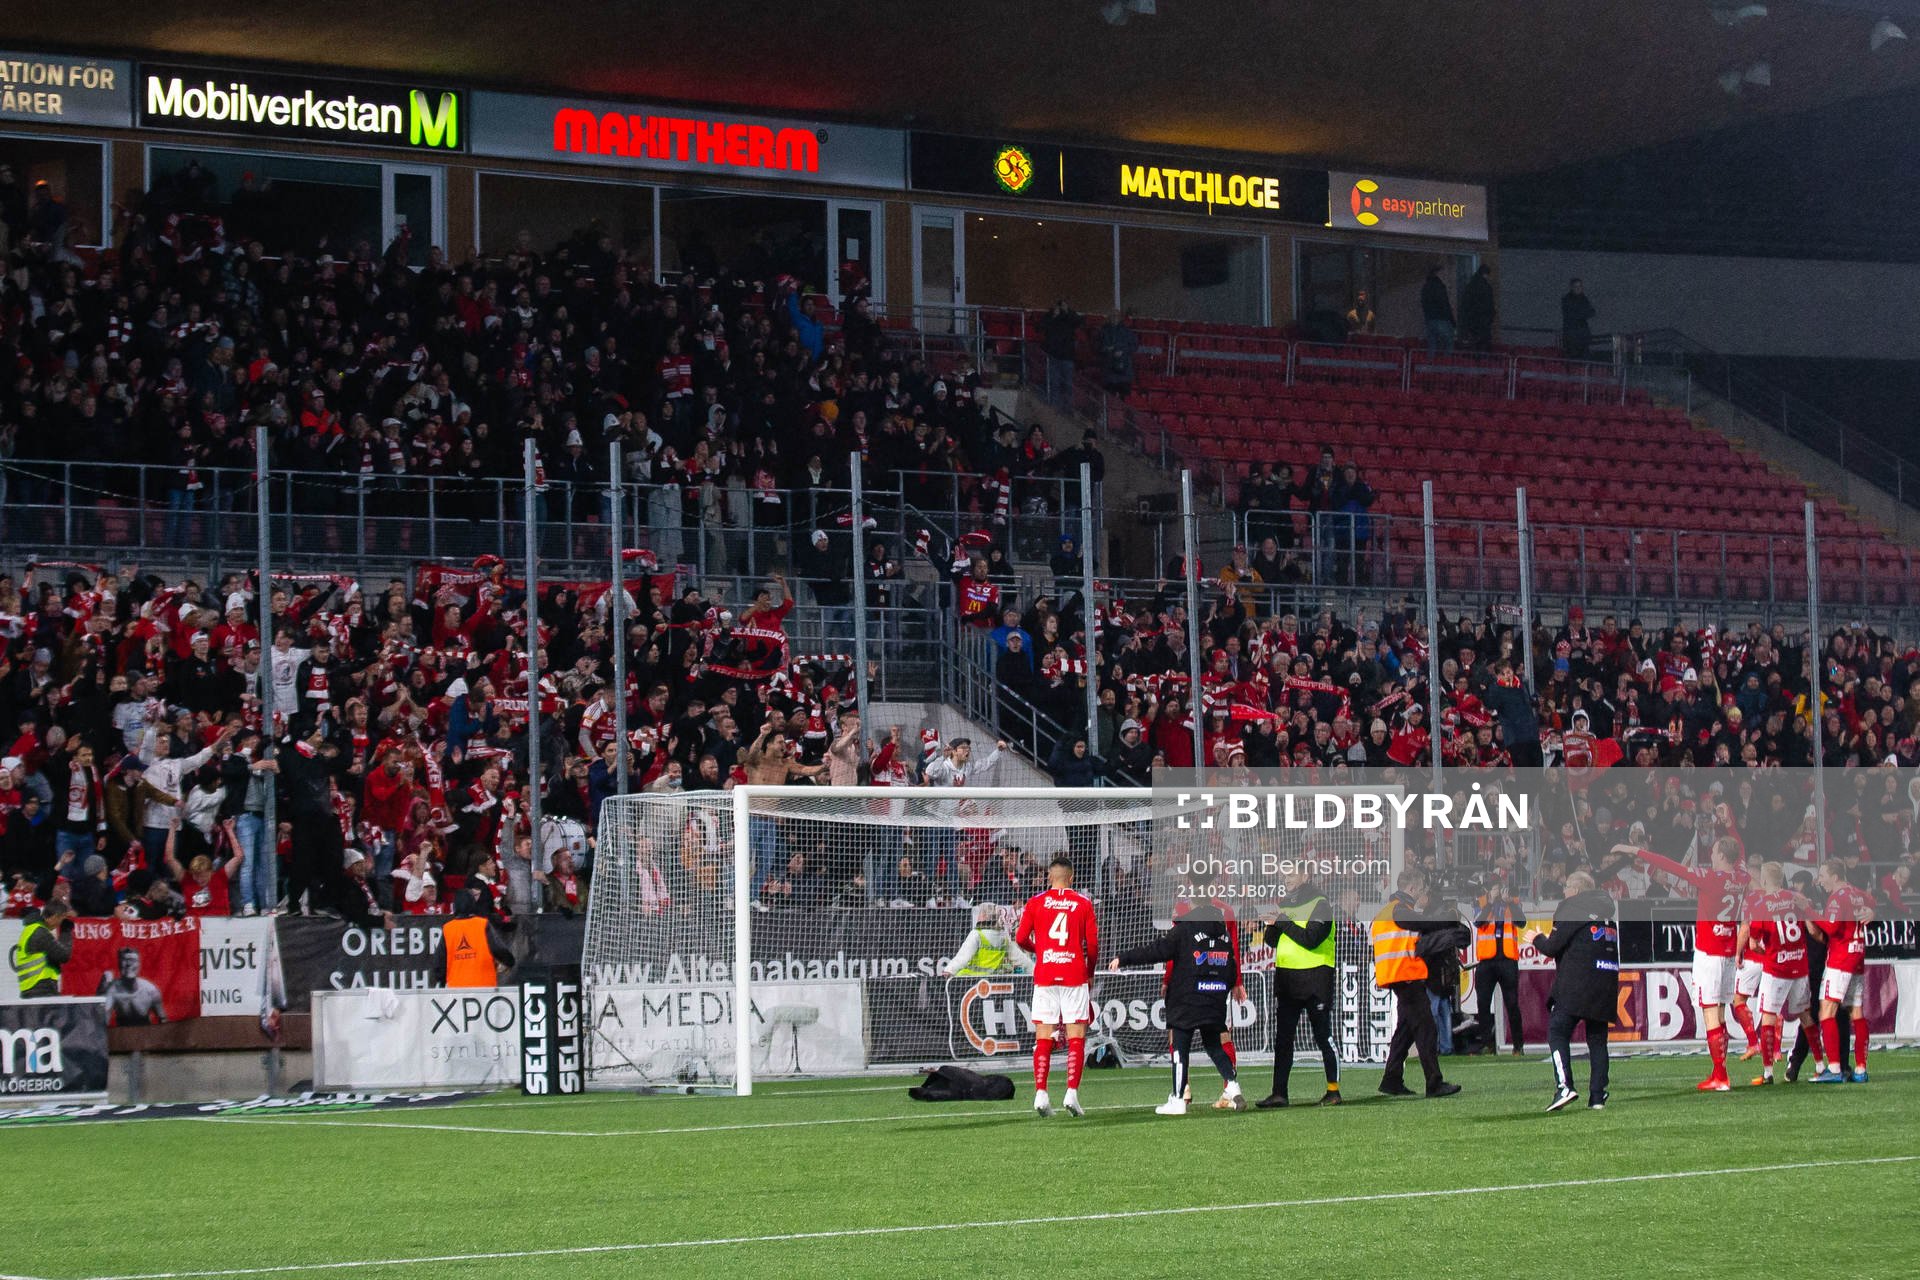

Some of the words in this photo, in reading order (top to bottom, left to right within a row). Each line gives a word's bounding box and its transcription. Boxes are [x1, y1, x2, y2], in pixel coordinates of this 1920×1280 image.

[68, 62, 115, 90] FÖR
[1, 84, 63, 115] ÄRER
[147, 76, 402, 133] Mobilverkstan
[409, 89, 458, 148] M
[553, 107, 819, 173] MAXITHERM
[1121, 164, 1280, 210] MATCHLOGE
[1381, 196, 1465, 220] easypartner
[74, 921, 112, 940] UNG
[341, 921, 443, 957] ÖREBR
[1048, 912, 1069, 946] 4
[1772, 912, 1801, 945] 18
[594, 951, 951, 986] ww.Altenabadrum.se
[1342, 963, 1359, 1062] SELECT
[1369, 962, 1392, 1063] SELEC
[431, 1039, 518, 1063] synligh
[525, 983, 548, 1095] SELECT
[557, 982, 580, 1094] SELECT
[8, 1077, 63, 1093] ÖREBRO
